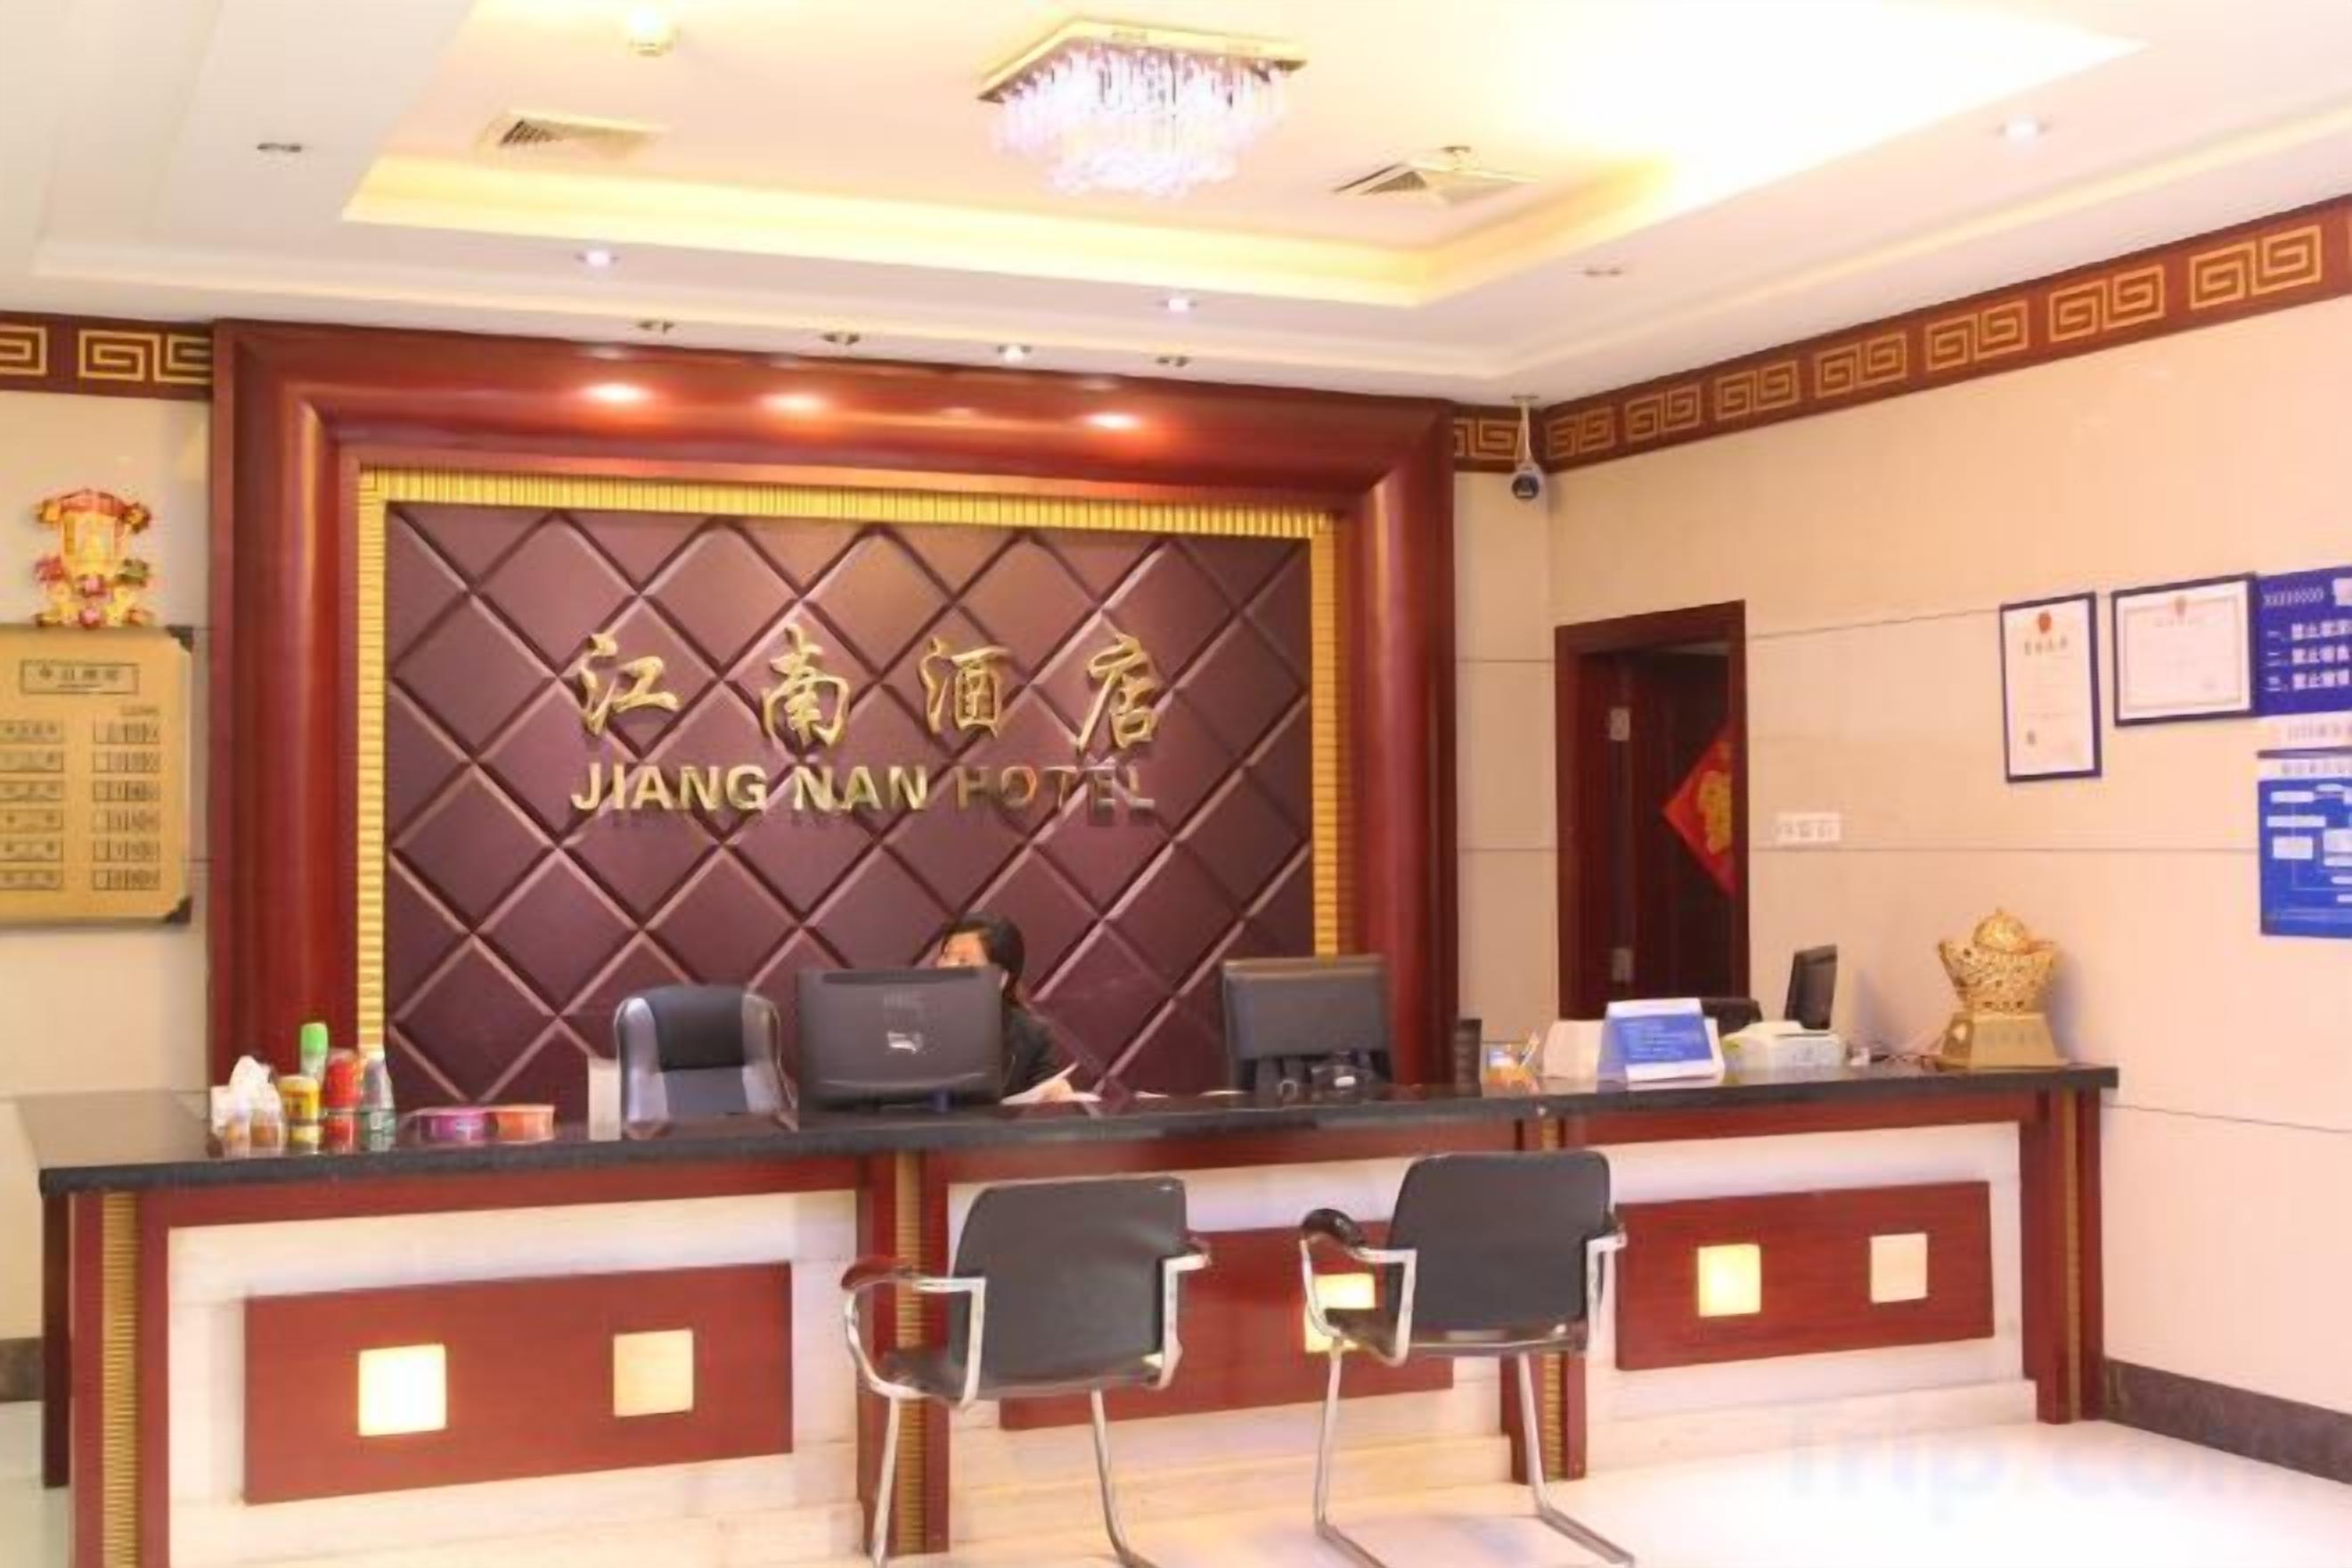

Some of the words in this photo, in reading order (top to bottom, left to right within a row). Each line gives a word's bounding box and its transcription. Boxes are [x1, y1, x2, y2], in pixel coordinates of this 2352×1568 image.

[577, 623, 1161, 750] 江南酒店
[571, 764, 767, 812] JIANG
[792, 764, 928, 813] NAN
[953, 764, 1156, 811] HOTEL
